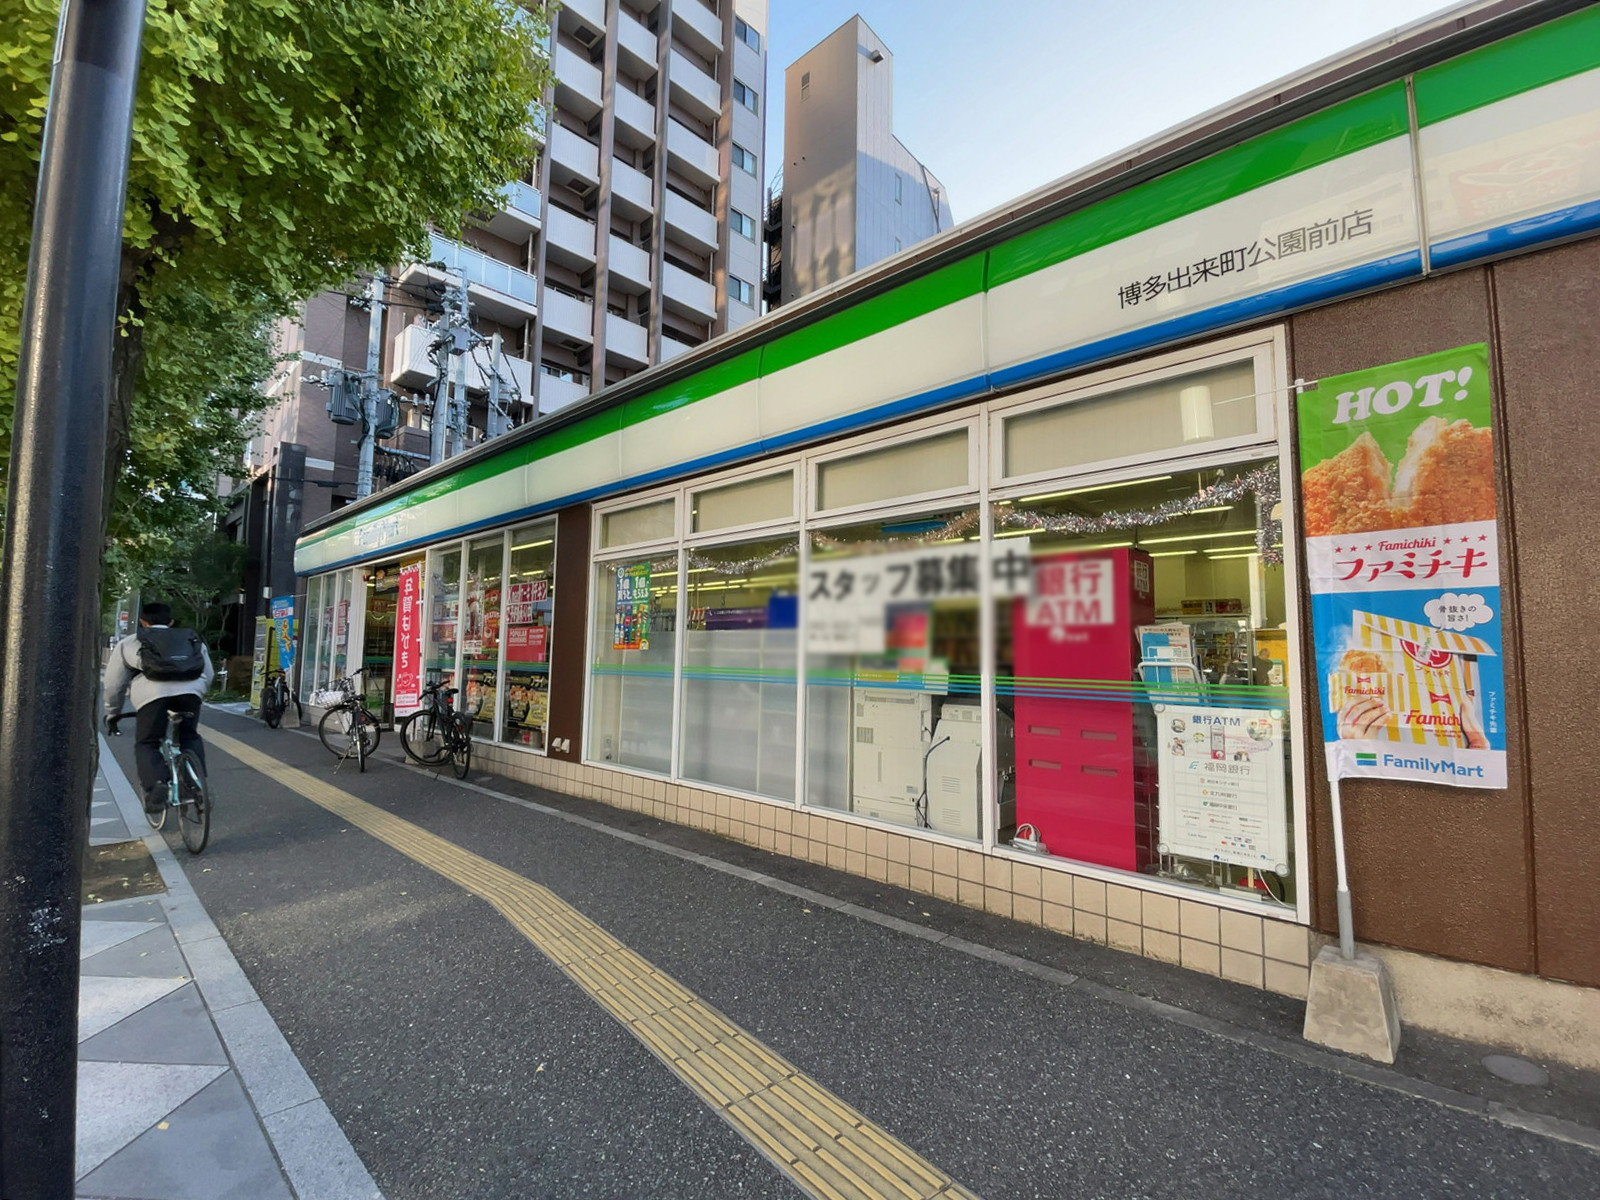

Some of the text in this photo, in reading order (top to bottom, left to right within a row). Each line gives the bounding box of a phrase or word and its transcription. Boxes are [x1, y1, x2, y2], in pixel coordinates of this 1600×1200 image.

[1117, 208, 1374, 309] 博多出来町公園前店
[1332, 366, 1473, 424] HOT!
[1378, 537, 1437, 551] Famichiki
[808, 549, 1029, 601] スタッフ募集中
[1336, 548, 1488, 582] ファミチキ
[1038, 561, 1102, 598] 銀行
[1037, 599, 1102, 623] ATM
[1438, 605, 1477, 614] 骨抜きの
[1344, 686, 1385, 696] Famichiki
[1205, 762, 1250, 776] 福岡銀行
[1383, 754, 1484, 778] FamilyMart
